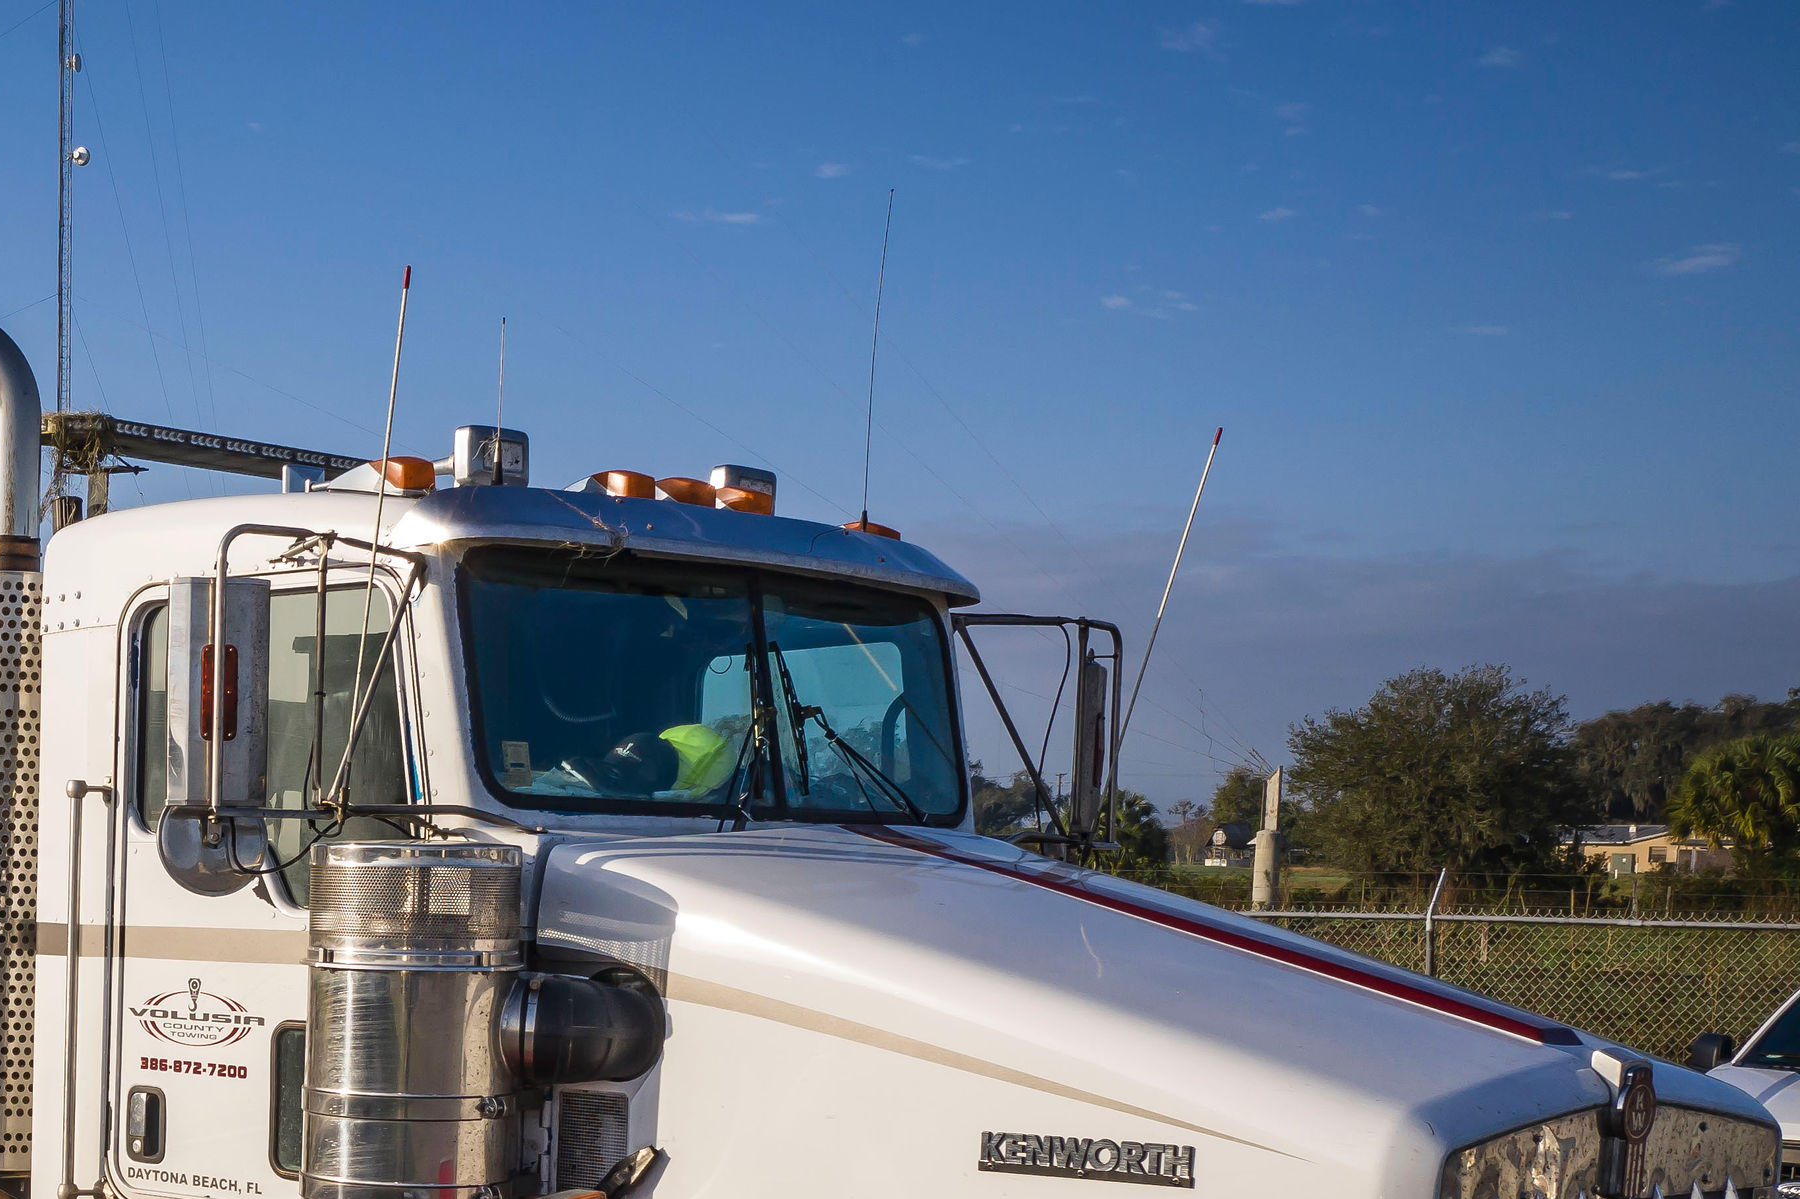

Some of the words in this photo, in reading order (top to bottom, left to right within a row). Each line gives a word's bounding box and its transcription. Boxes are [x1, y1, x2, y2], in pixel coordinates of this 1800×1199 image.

[128, 1007, 266, 1026] VOLUSIA
[163, 1022, 224, 1033] COUNTY
[170, 1031, 217, 1041] TOWING
[140, 1057, 248, 1079] 386-872-7200
[980, 1130, 1196, 1180] KENWORTH
[127, 1167, 188, 1186] DAYTONA
[192, 1175, 242, 1195] BEACH,
[246, 1182, 263, 1195] FL
